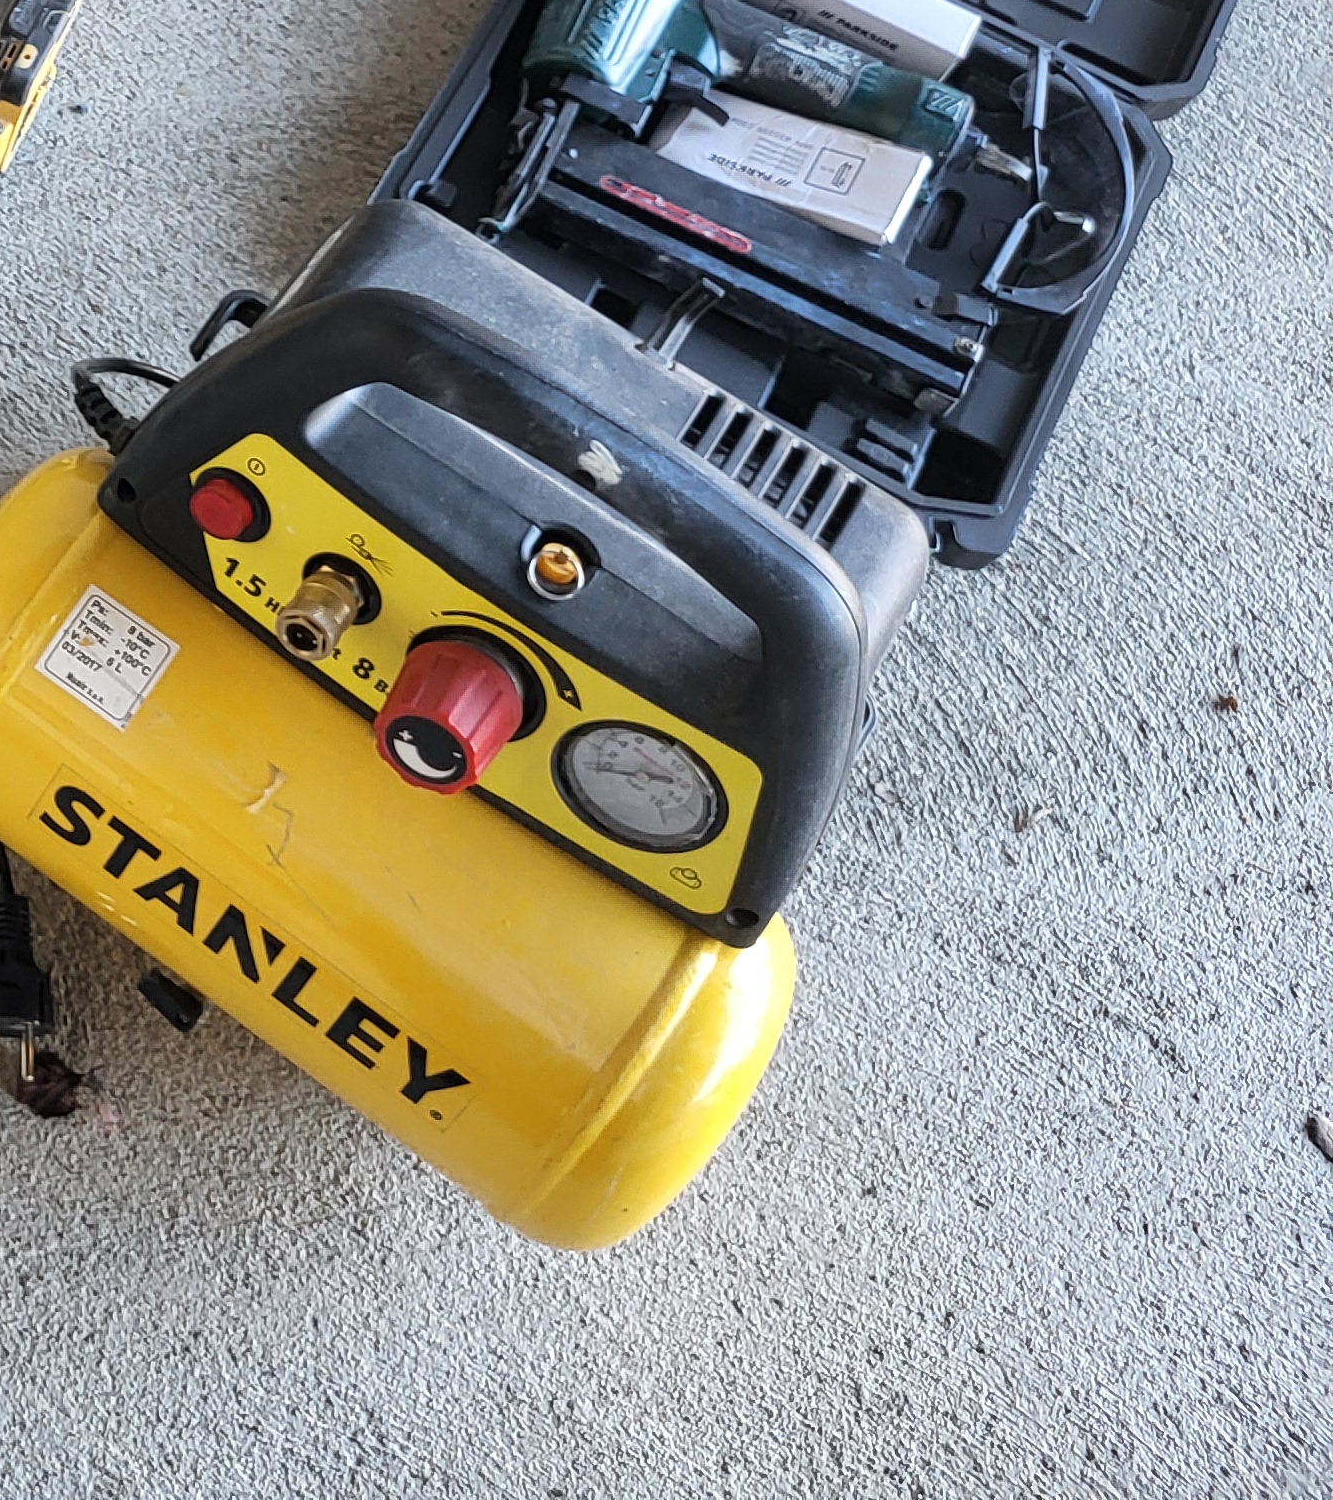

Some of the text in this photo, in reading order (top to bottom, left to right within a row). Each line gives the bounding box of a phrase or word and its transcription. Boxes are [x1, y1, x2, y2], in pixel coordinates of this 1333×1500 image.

[836, 18, 899, 51] PARKSIDE
[708, 153, 772, 182] PARKSIDE
[223, 557, 267, 597] 1.5
[85, 609, 114, 635] Tmin:
[136, 630, 156, 648] bar
[61, 640, 103, 672] 03/2017
[352, 657, 376, 680] 8
[39, 785, 471, 1104] STANLEY
